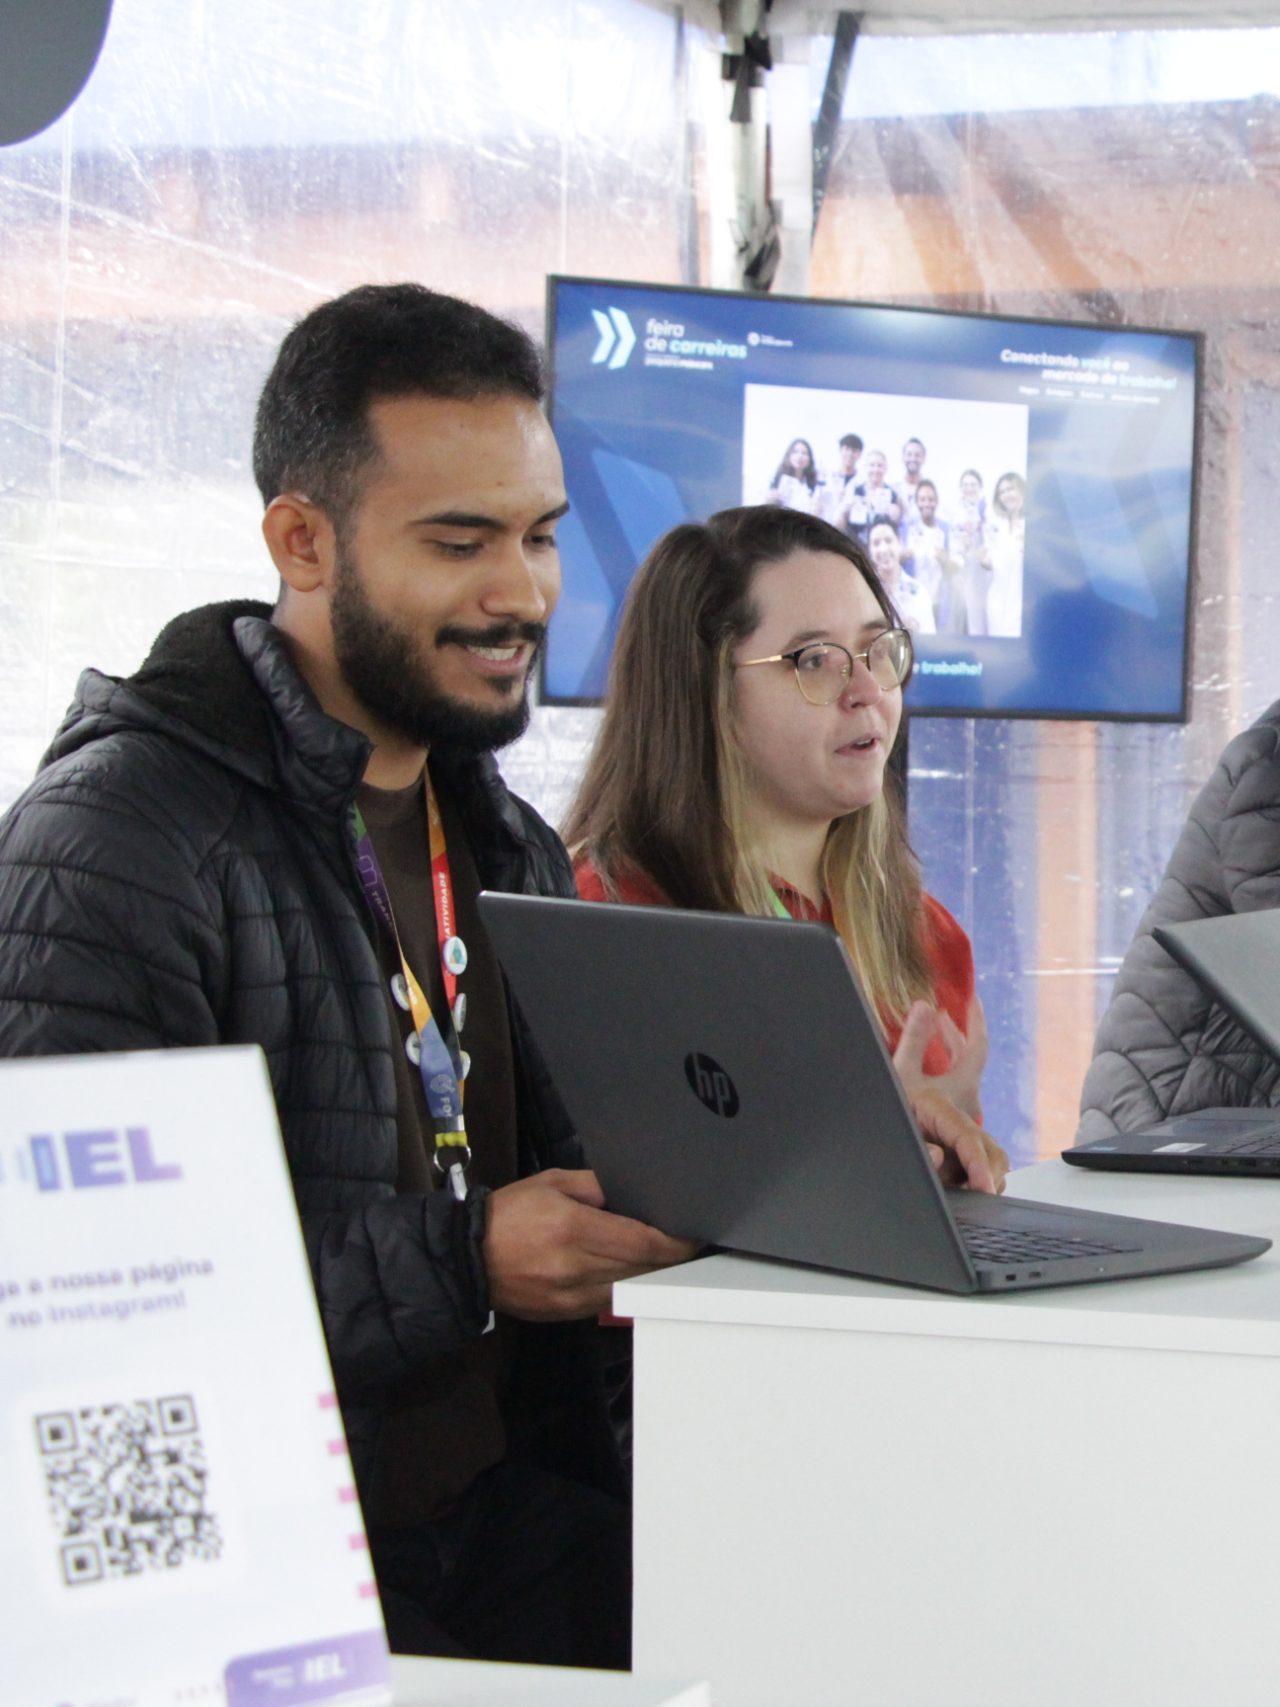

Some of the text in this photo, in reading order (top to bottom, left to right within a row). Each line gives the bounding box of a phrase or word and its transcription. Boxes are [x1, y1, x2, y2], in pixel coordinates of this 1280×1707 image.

[646, 318, 684, 338] feira
[644, 336, 667, 352] de
[669, 339, 748, 359] carreiras
[1001, 349, 1079, 368] Conectando
[29, 1126, 184, 1193] IEL
[51, 1270, 123, 1292] nossa
[130, 1256, 215, 1286] página
[8, 1310, 43, 1328] no
[304, 1653, 346, 1682] IEL
